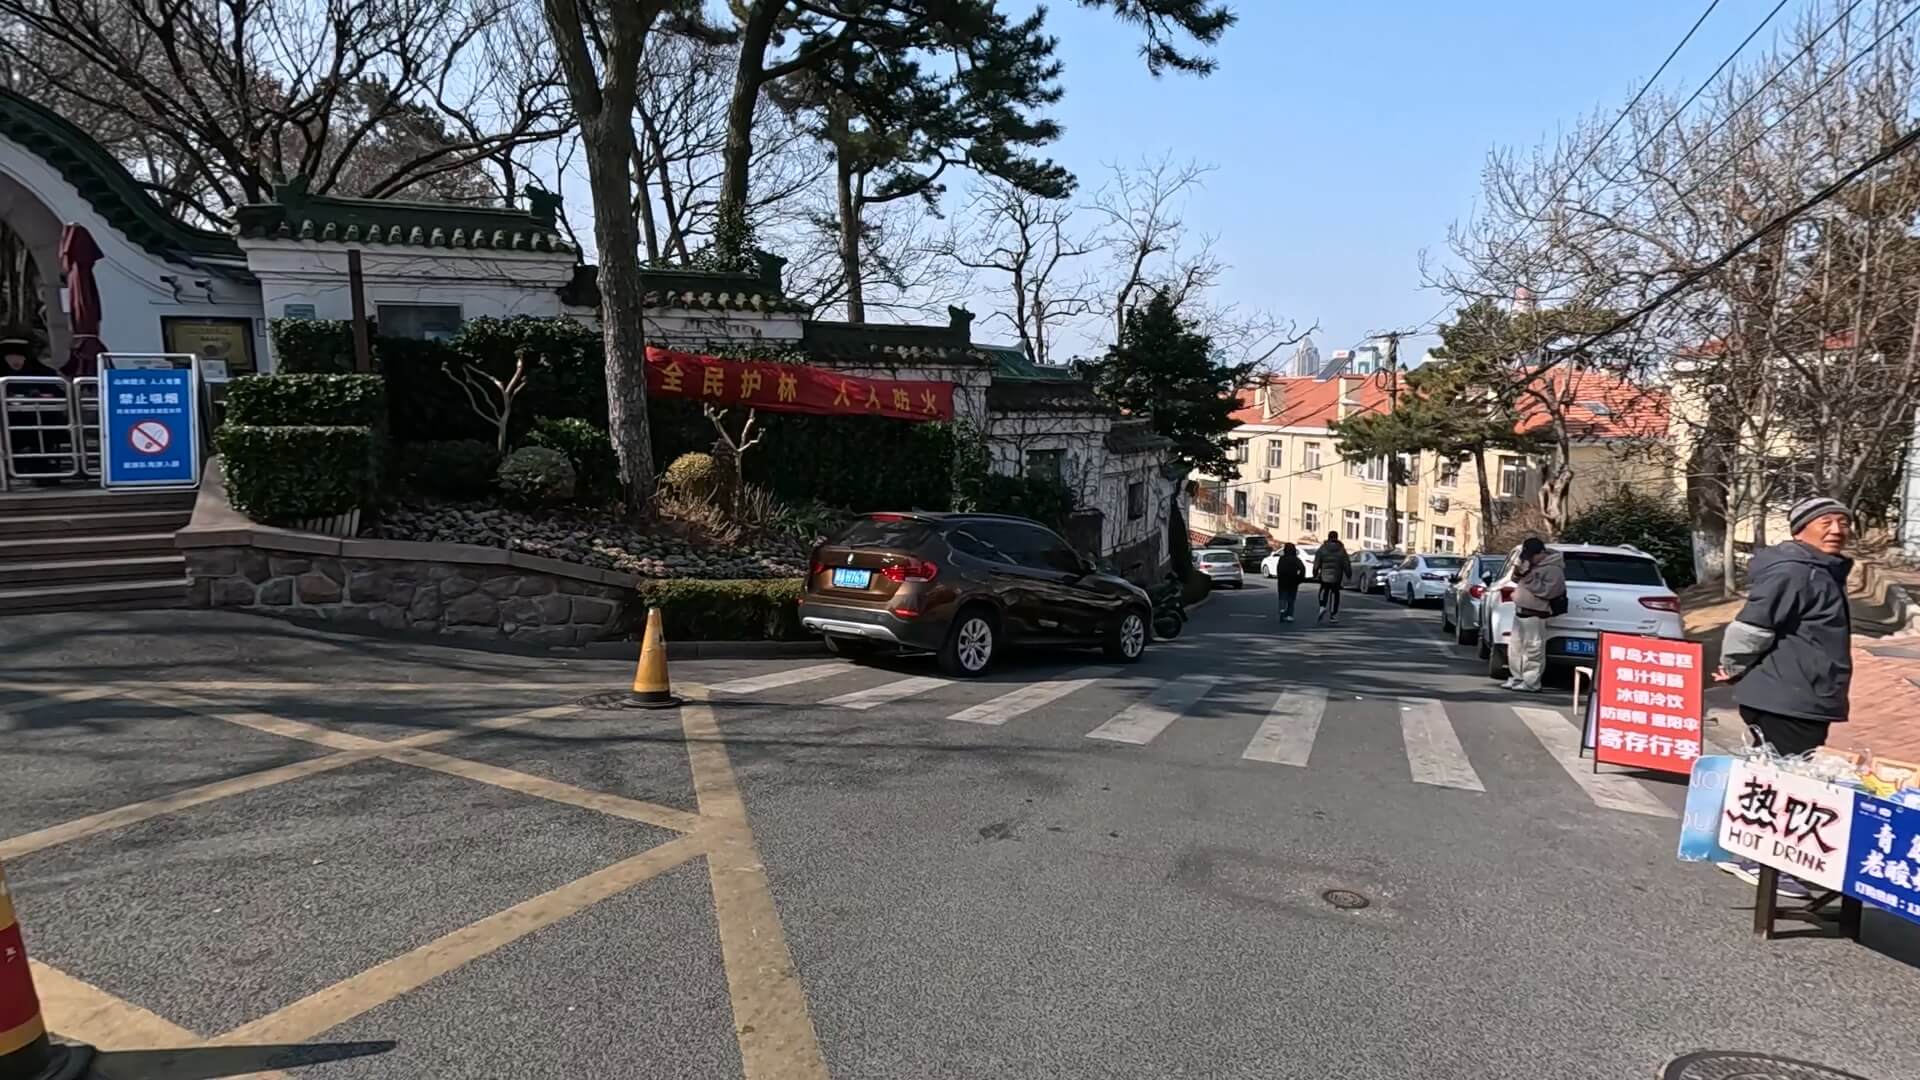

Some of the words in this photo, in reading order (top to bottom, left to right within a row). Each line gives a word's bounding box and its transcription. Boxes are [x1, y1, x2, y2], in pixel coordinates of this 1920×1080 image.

[119, 393, 179, 405] 禁止吸烟
[661, 362, 797, 402] 全民护林
[833, 379, 937, 414] 人人防火
[1616, 687, 1685, 710] 冰镇冷饮
[1599, 727, 1700, 760] 寄存行李
[1726, 776, 1840, 854] 热饮
[1728, 827, 1763, 850] HOT
[1772, 844, 1827, 873] DRINK
